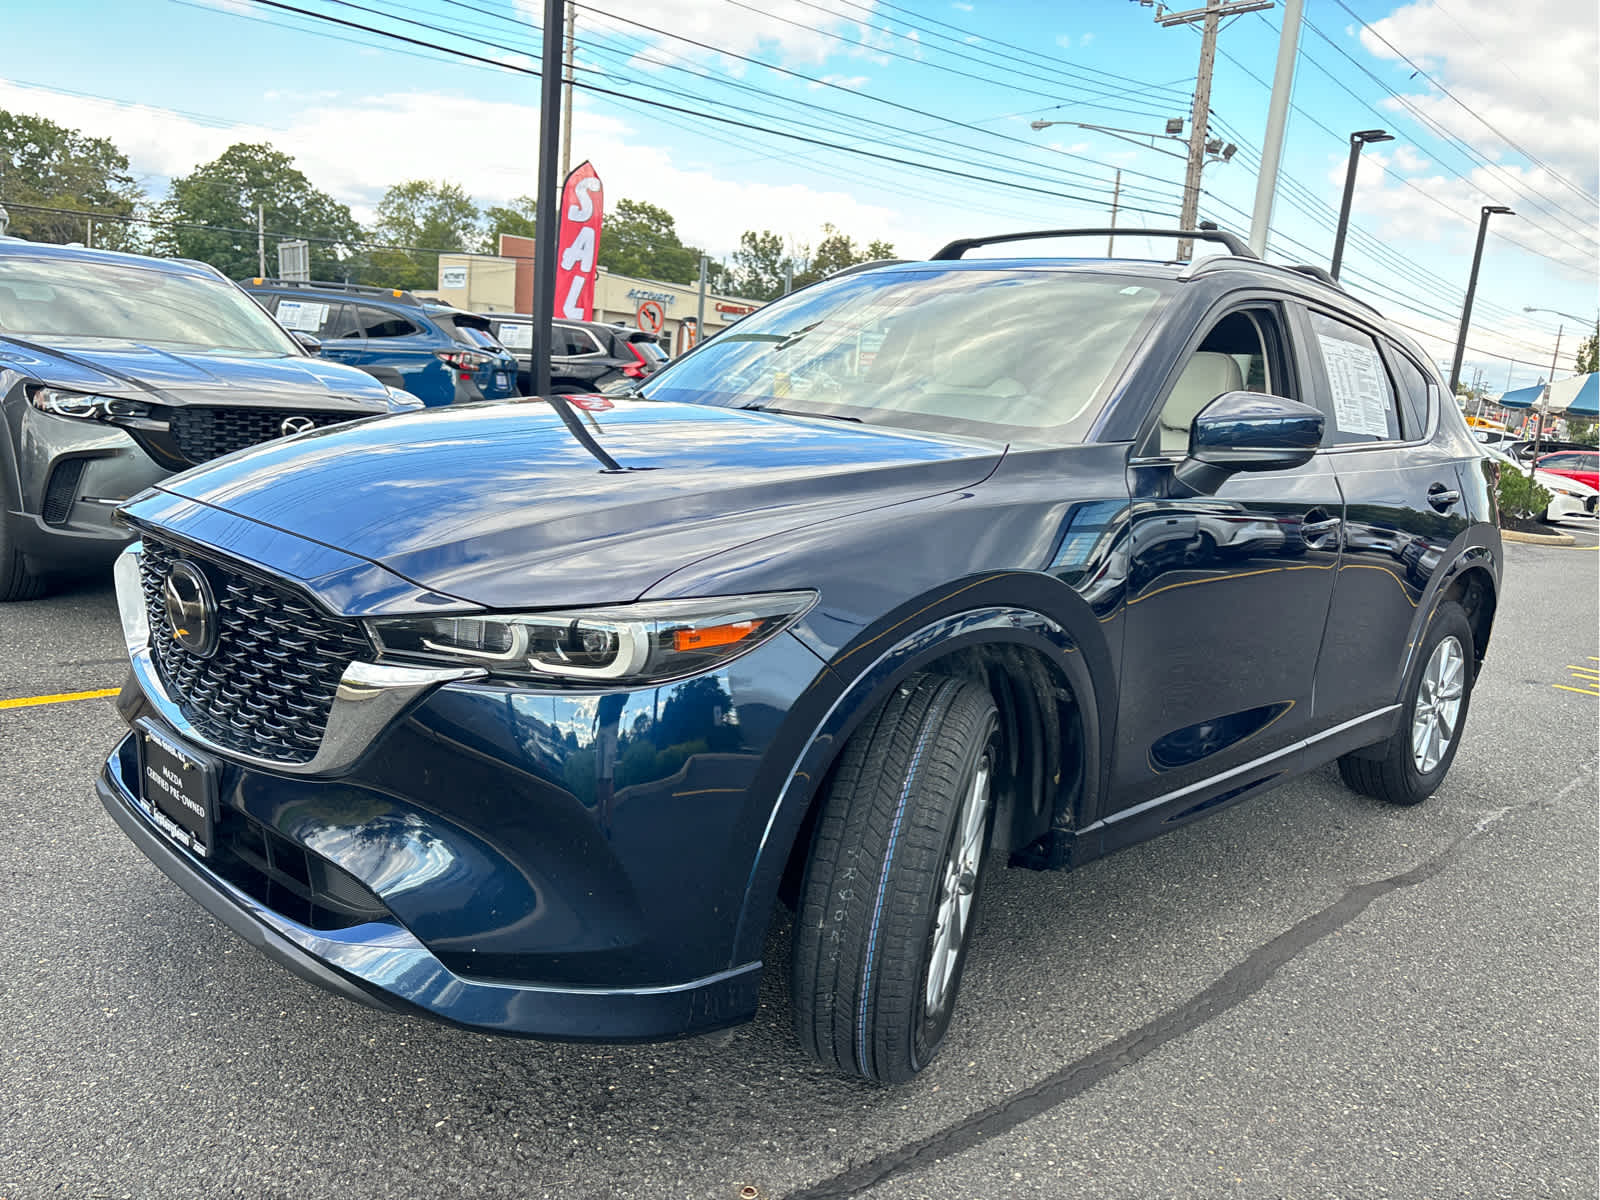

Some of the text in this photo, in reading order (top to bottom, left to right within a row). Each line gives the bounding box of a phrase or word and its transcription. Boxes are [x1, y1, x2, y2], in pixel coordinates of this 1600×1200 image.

[146, 766, 205, 818] CERTIFIED PRE-OWNED
[162, 765, 183, 789] MAZDA
